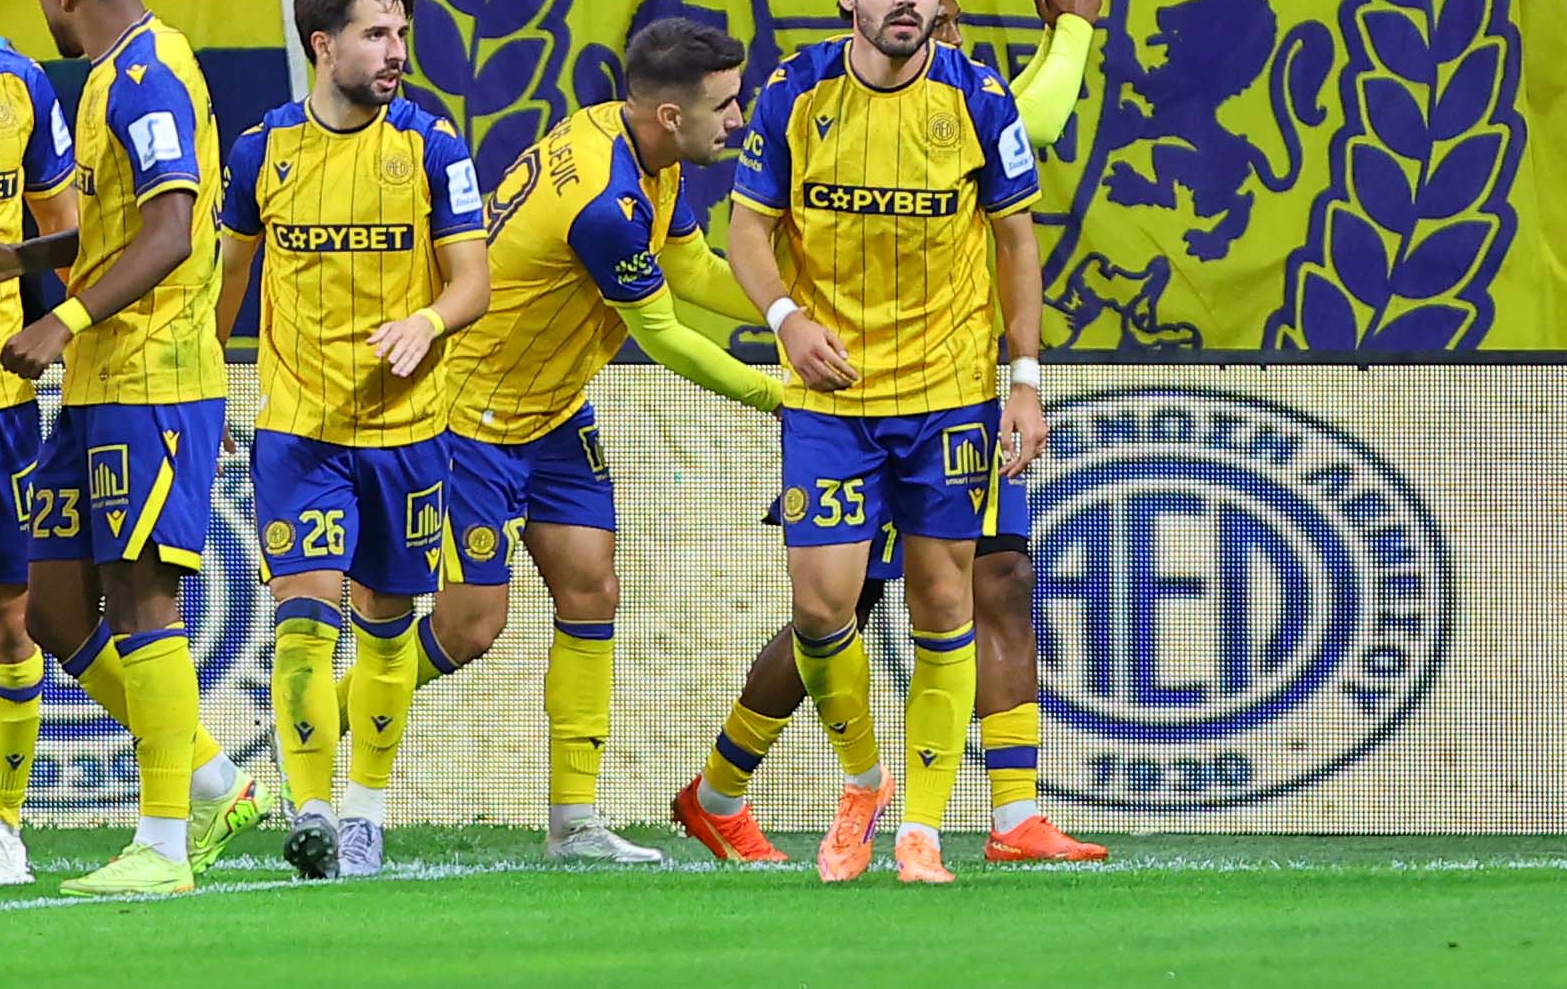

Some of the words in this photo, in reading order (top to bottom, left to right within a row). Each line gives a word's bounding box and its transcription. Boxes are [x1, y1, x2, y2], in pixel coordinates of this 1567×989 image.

[809, 186, 953, 215] COPYBET
[276, 226, 408, 250] COPYBET
[34, 488, 81, 539] 23
[814, 478, 866, 527] 35
[299, 509, 345, 557] 26
[1087, 751, 1256, 793] 1930
